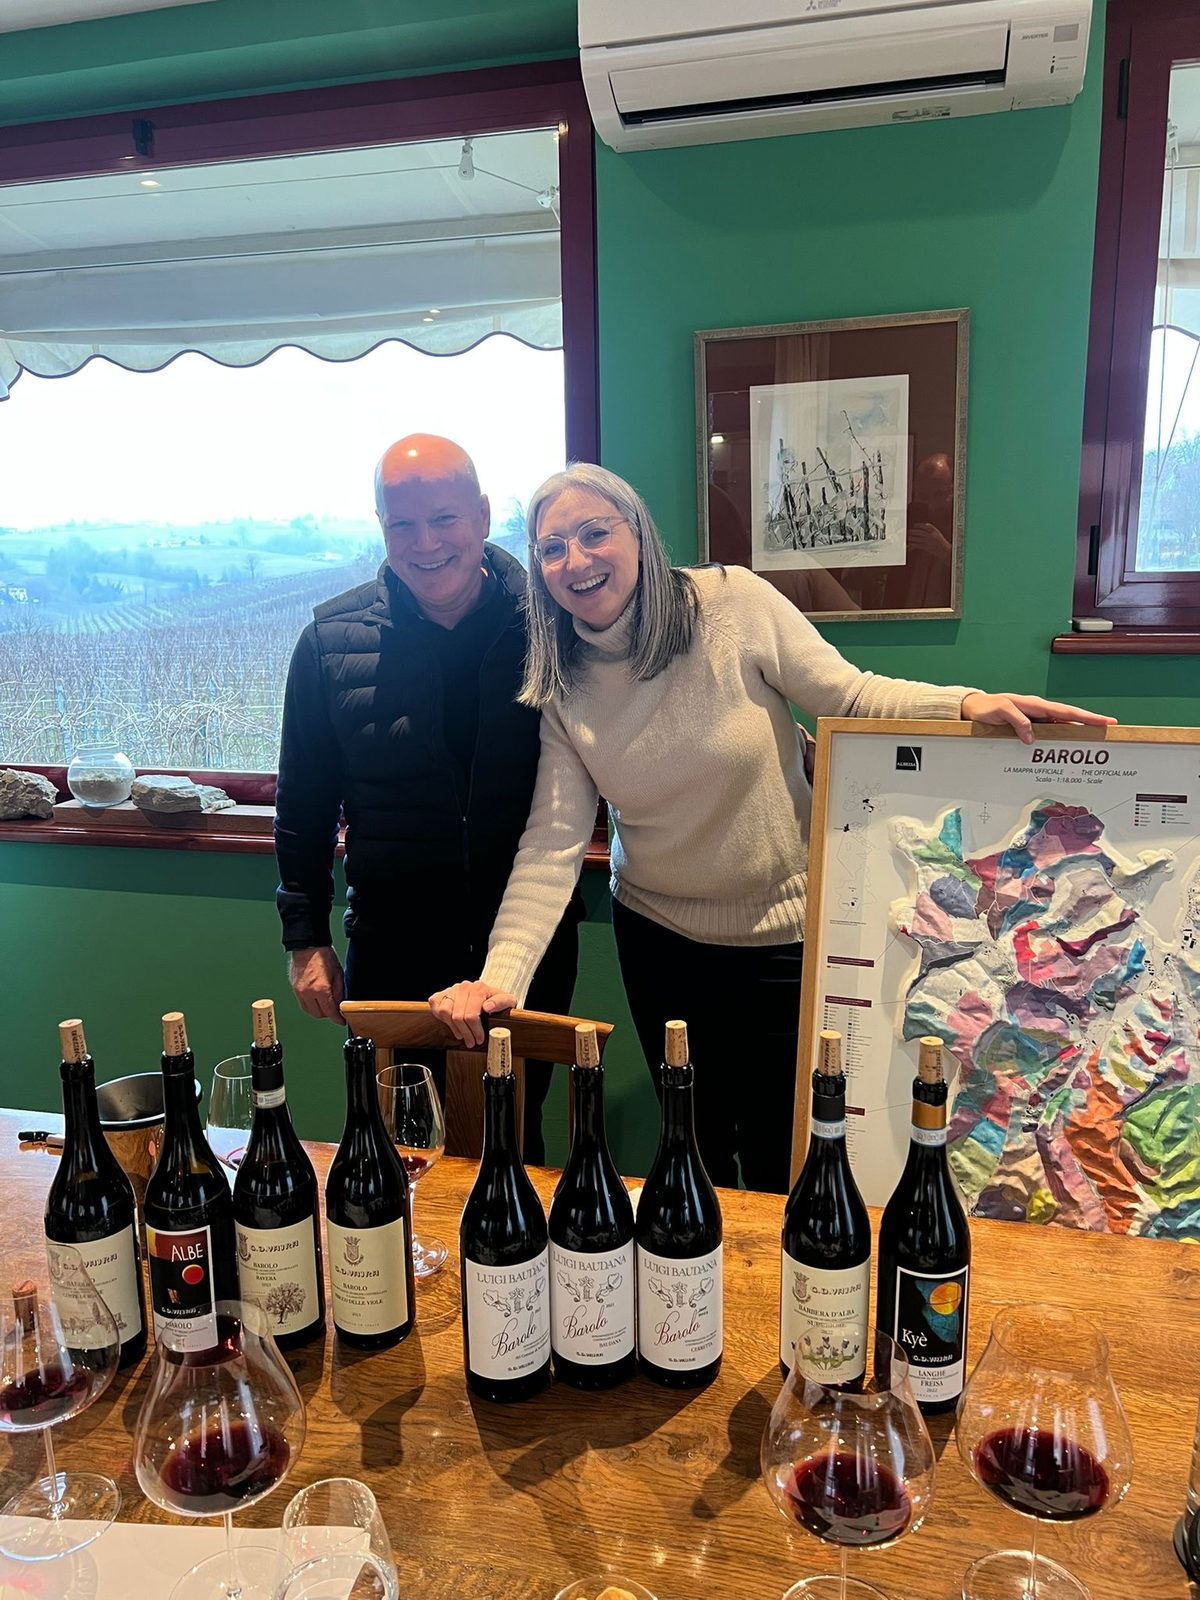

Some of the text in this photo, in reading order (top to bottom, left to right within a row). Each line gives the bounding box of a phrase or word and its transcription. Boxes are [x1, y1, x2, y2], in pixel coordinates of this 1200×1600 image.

[1031, 748, 1110, 765] BAROLO
[1012, 767, 1034, 775] MAPPA
[1034, 767, 1064, 775] UFFICIALE
[1094, 769, 1121, 777] OFFICIAL
[170, 1243, 204, 1262] ALBE
[553, 1251, 627, 1271] LUIGI BAUDANA
[644, 1258, 718, 1276] LUIGI BAUDANA
[476, 1272, 507, 1284] LUIGI
[342, 1283, 368, 1292] BAROLO
[798, 1304, 855, 1318] BARBERA D'ALBA
[562, 1304, 609, 1340] Barolo
[654, 1309, 701, 1346] Barolo
[491, 1311, 537, 1360] Barolo
[902, 1328, 928, 1349] Kyè
[918, 1370, 946, 1378] LANGHE
